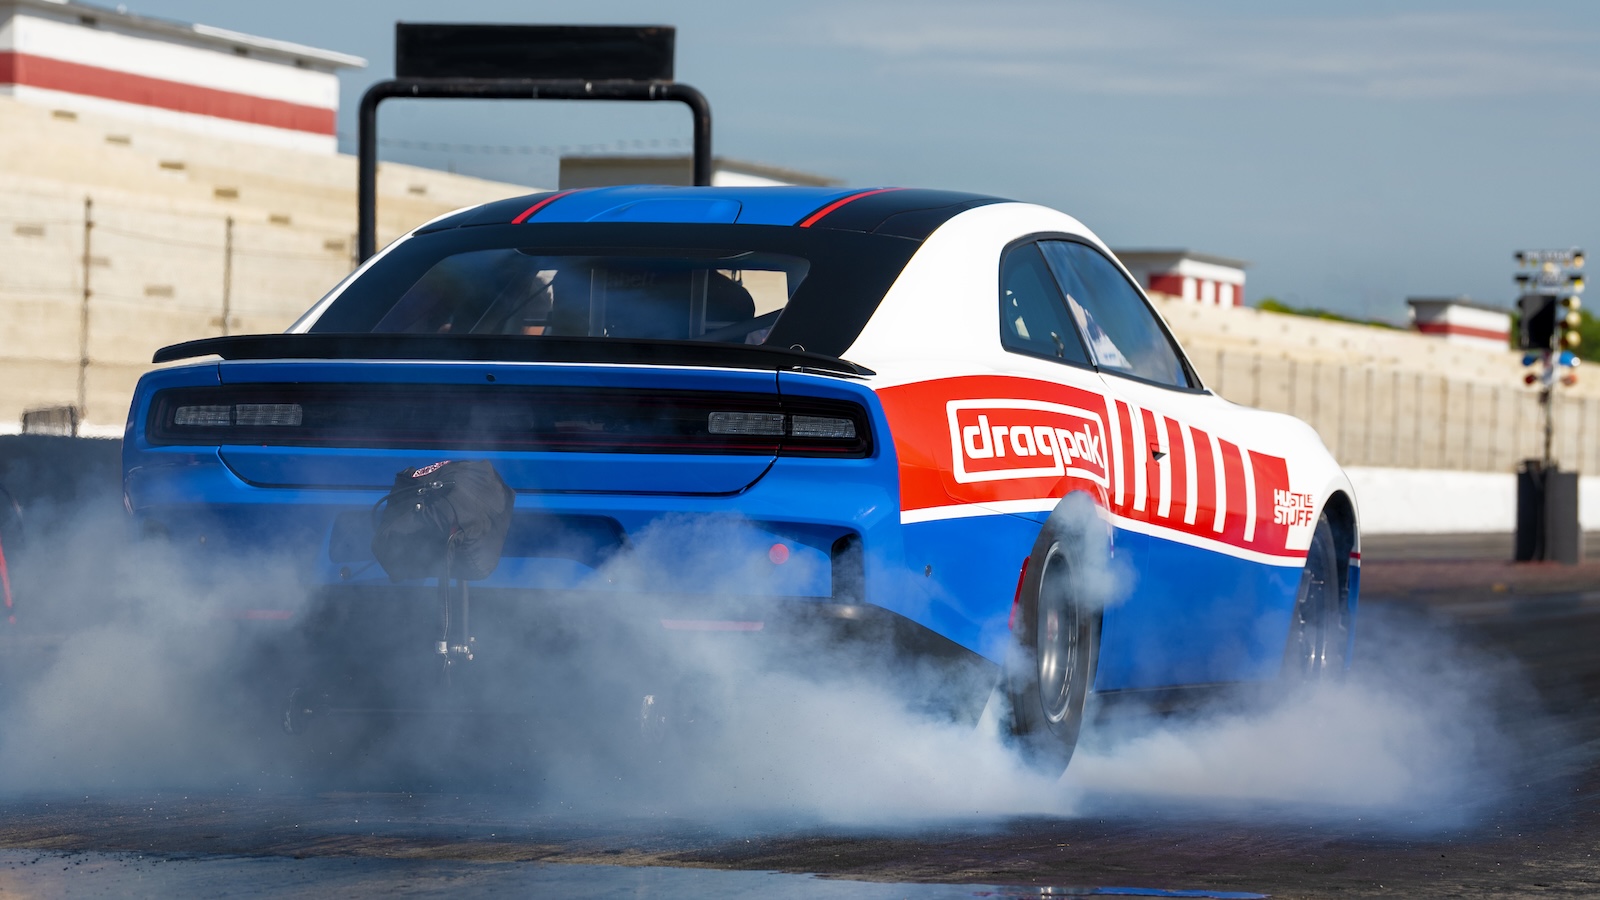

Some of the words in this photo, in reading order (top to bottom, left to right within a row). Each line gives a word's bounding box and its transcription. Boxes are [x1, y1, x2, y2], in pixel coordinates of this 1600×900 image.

[607, 271, 656, 288] abelt
[963, 414, 1104, 472] dragpak
[1273, 488, 1313, 508] HUSTLE
[1273, 505, 1313, 527] STUFF
